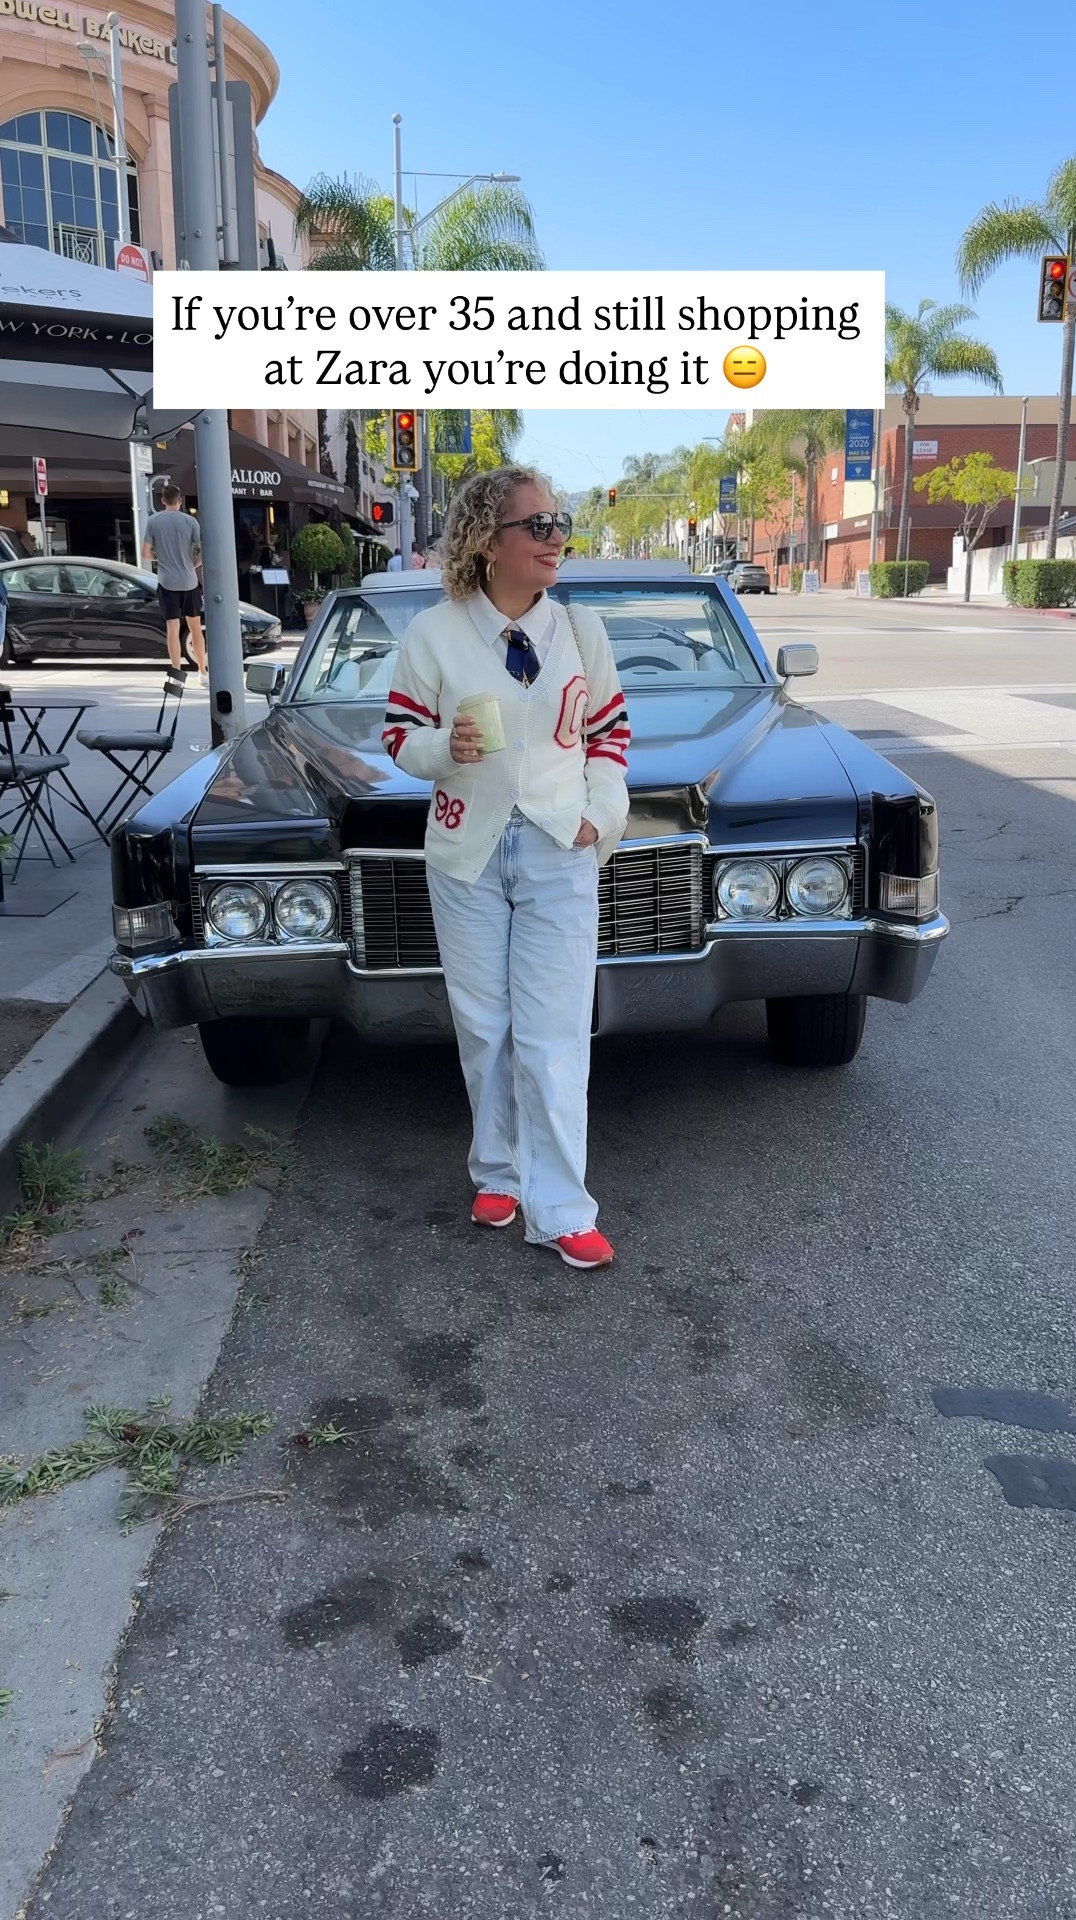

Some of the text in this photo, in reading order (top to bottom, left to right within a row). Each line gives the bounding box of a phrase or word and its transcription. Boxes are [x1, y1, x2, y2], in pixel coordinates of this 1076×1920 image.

[121, 253, 144, 268] DO NOT
[32, 322, 99, 340] YORK
[849, 439, 870, 448] 2026
[231, 469, 281, 485] ALLORO
[260, 489, 273, 497] BAR
[435, 789, 465, 829] 98
